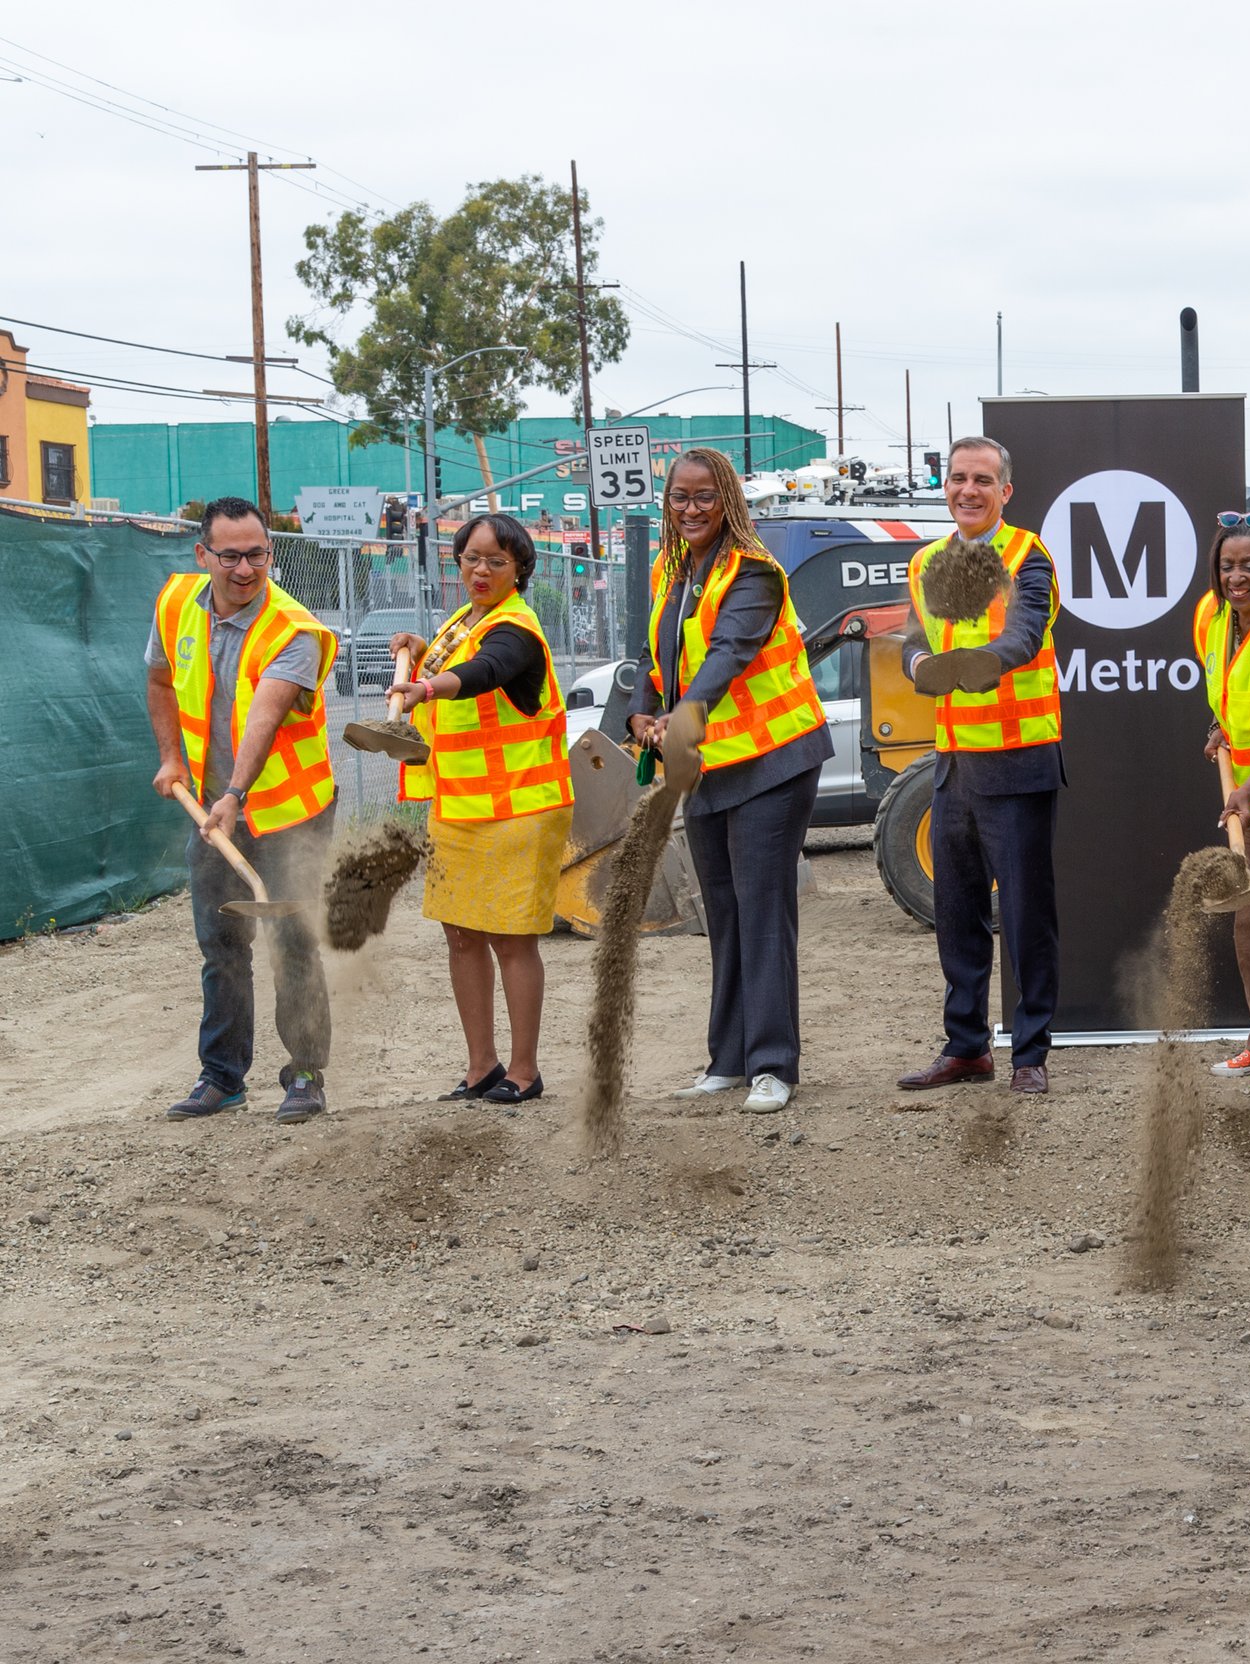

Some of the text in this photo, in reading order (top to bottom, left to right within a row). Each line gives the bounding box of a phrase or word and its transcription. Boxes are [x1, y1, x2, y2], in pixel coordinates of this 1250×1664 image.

[594, 434, 644, 448] SPEED
[600, 452, 640, 465] LIMIT
[600, 469, 646, 498] 35
[1070, 501, 1168, 599] M
[840, 561, 908, 588] DEE
[1055, 648, 1200, 692] Metro
